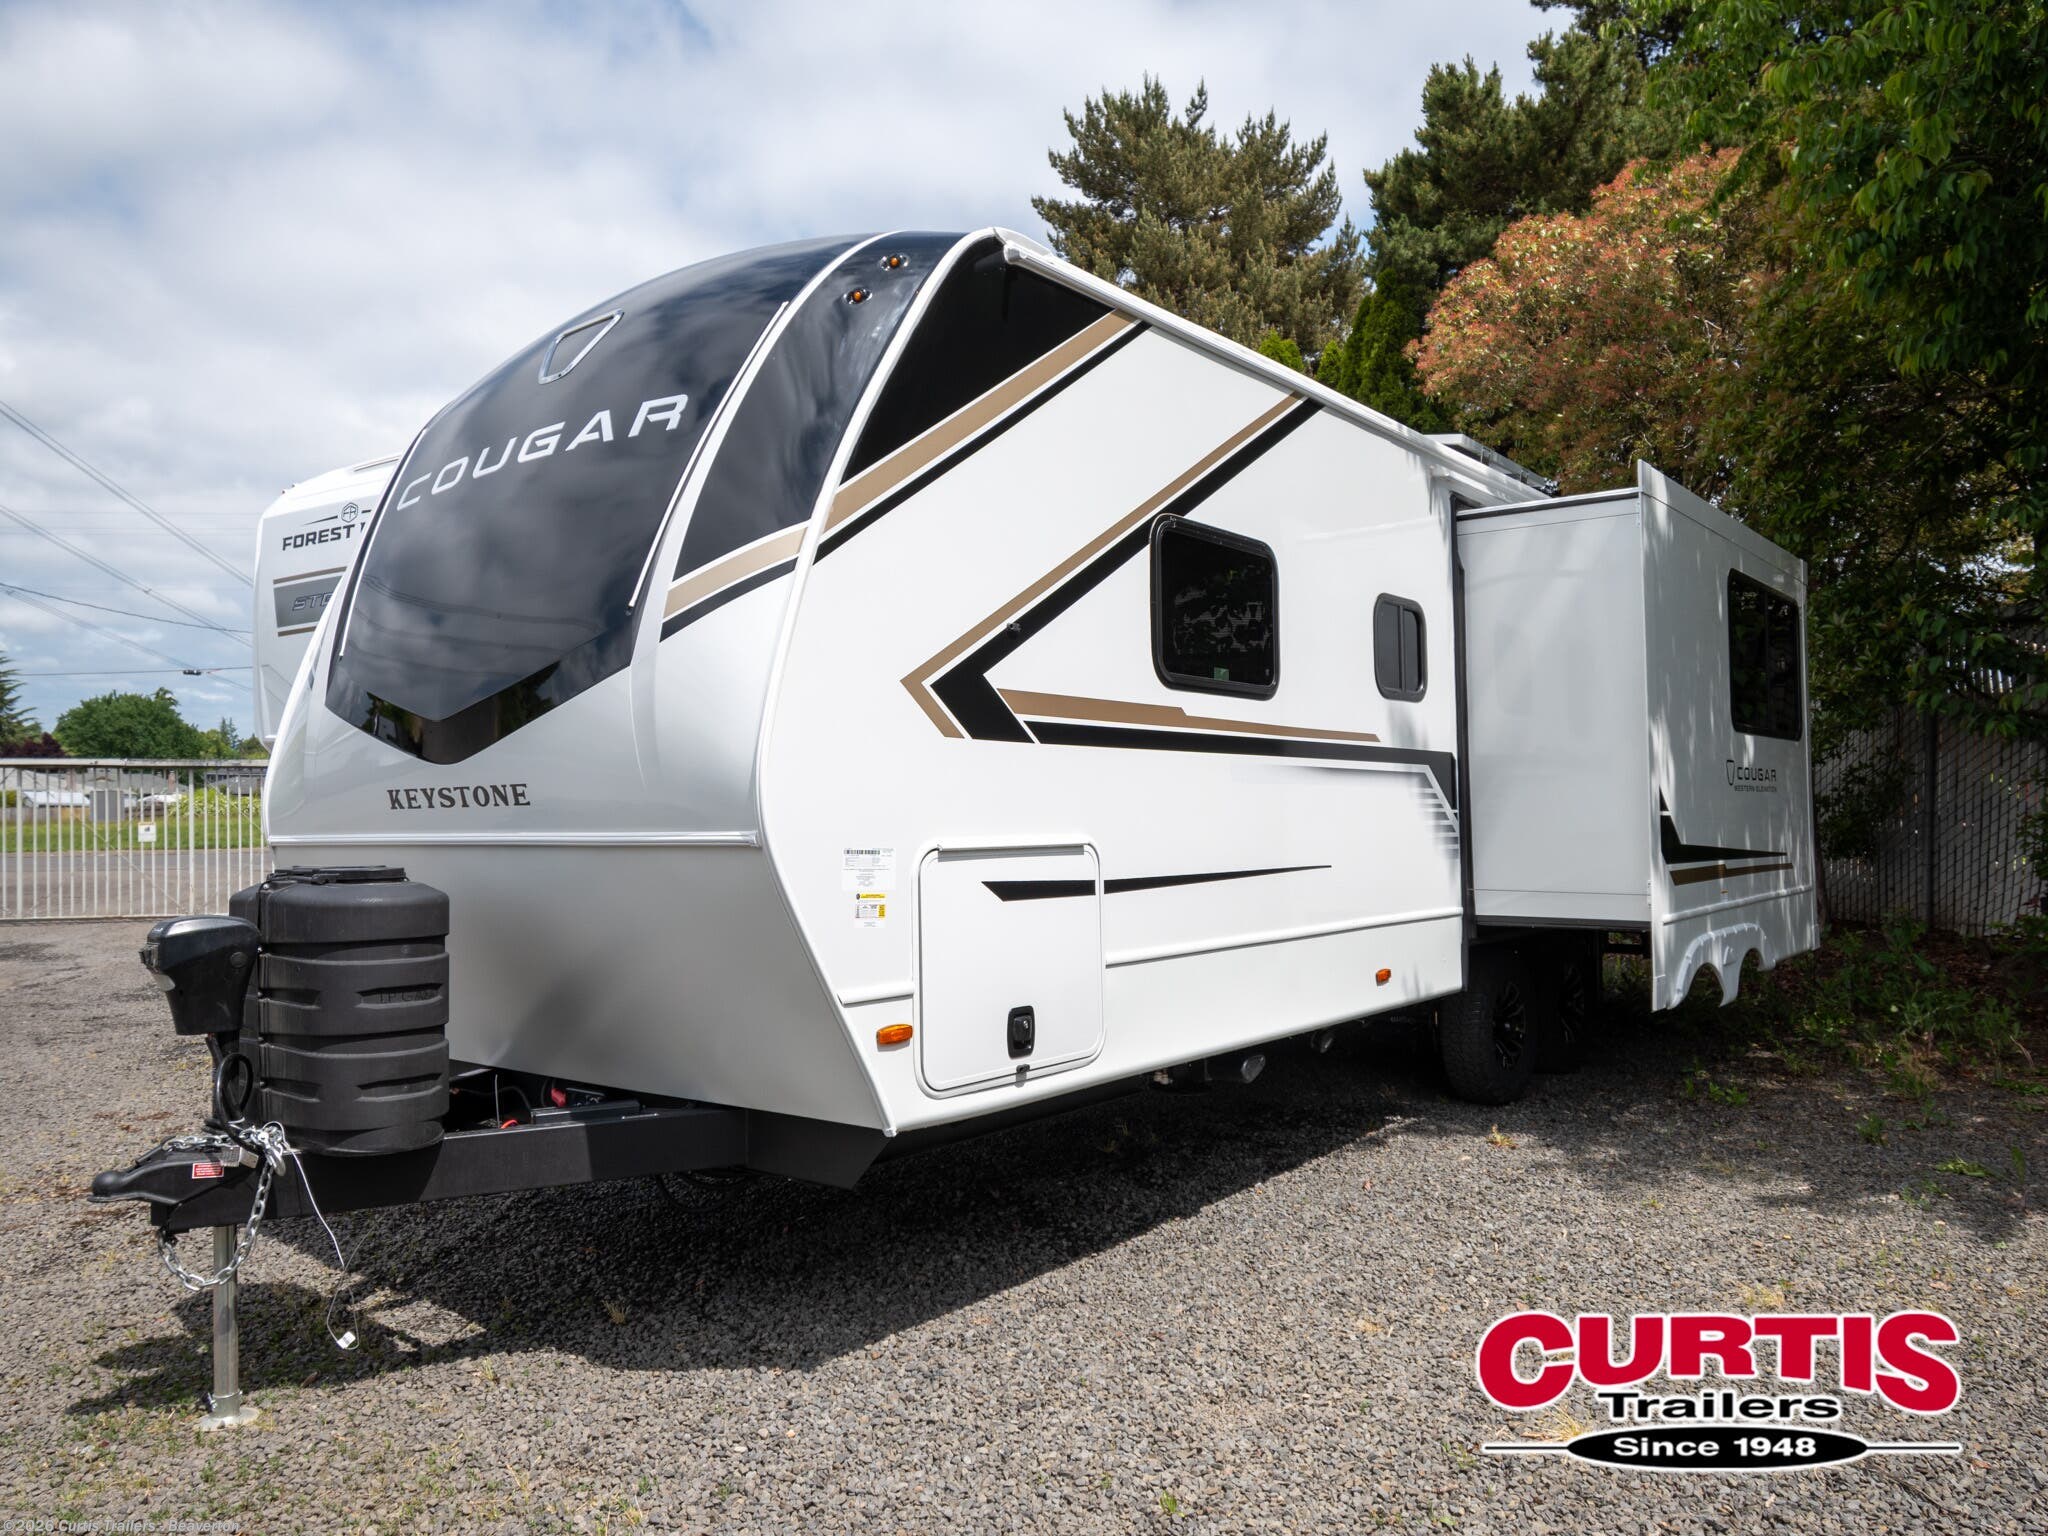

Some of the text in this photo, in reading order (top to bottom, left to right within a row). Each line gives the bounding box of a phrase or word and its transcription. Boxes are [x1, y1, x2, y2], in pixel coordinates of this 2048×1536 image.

[396, 393, 689, 511] COUGAR
[282, 524, 356, 551] FOREST
[1737, 767, 1777, 782] COUGAR
[387, 783, 531, 810] KEYSTONE
